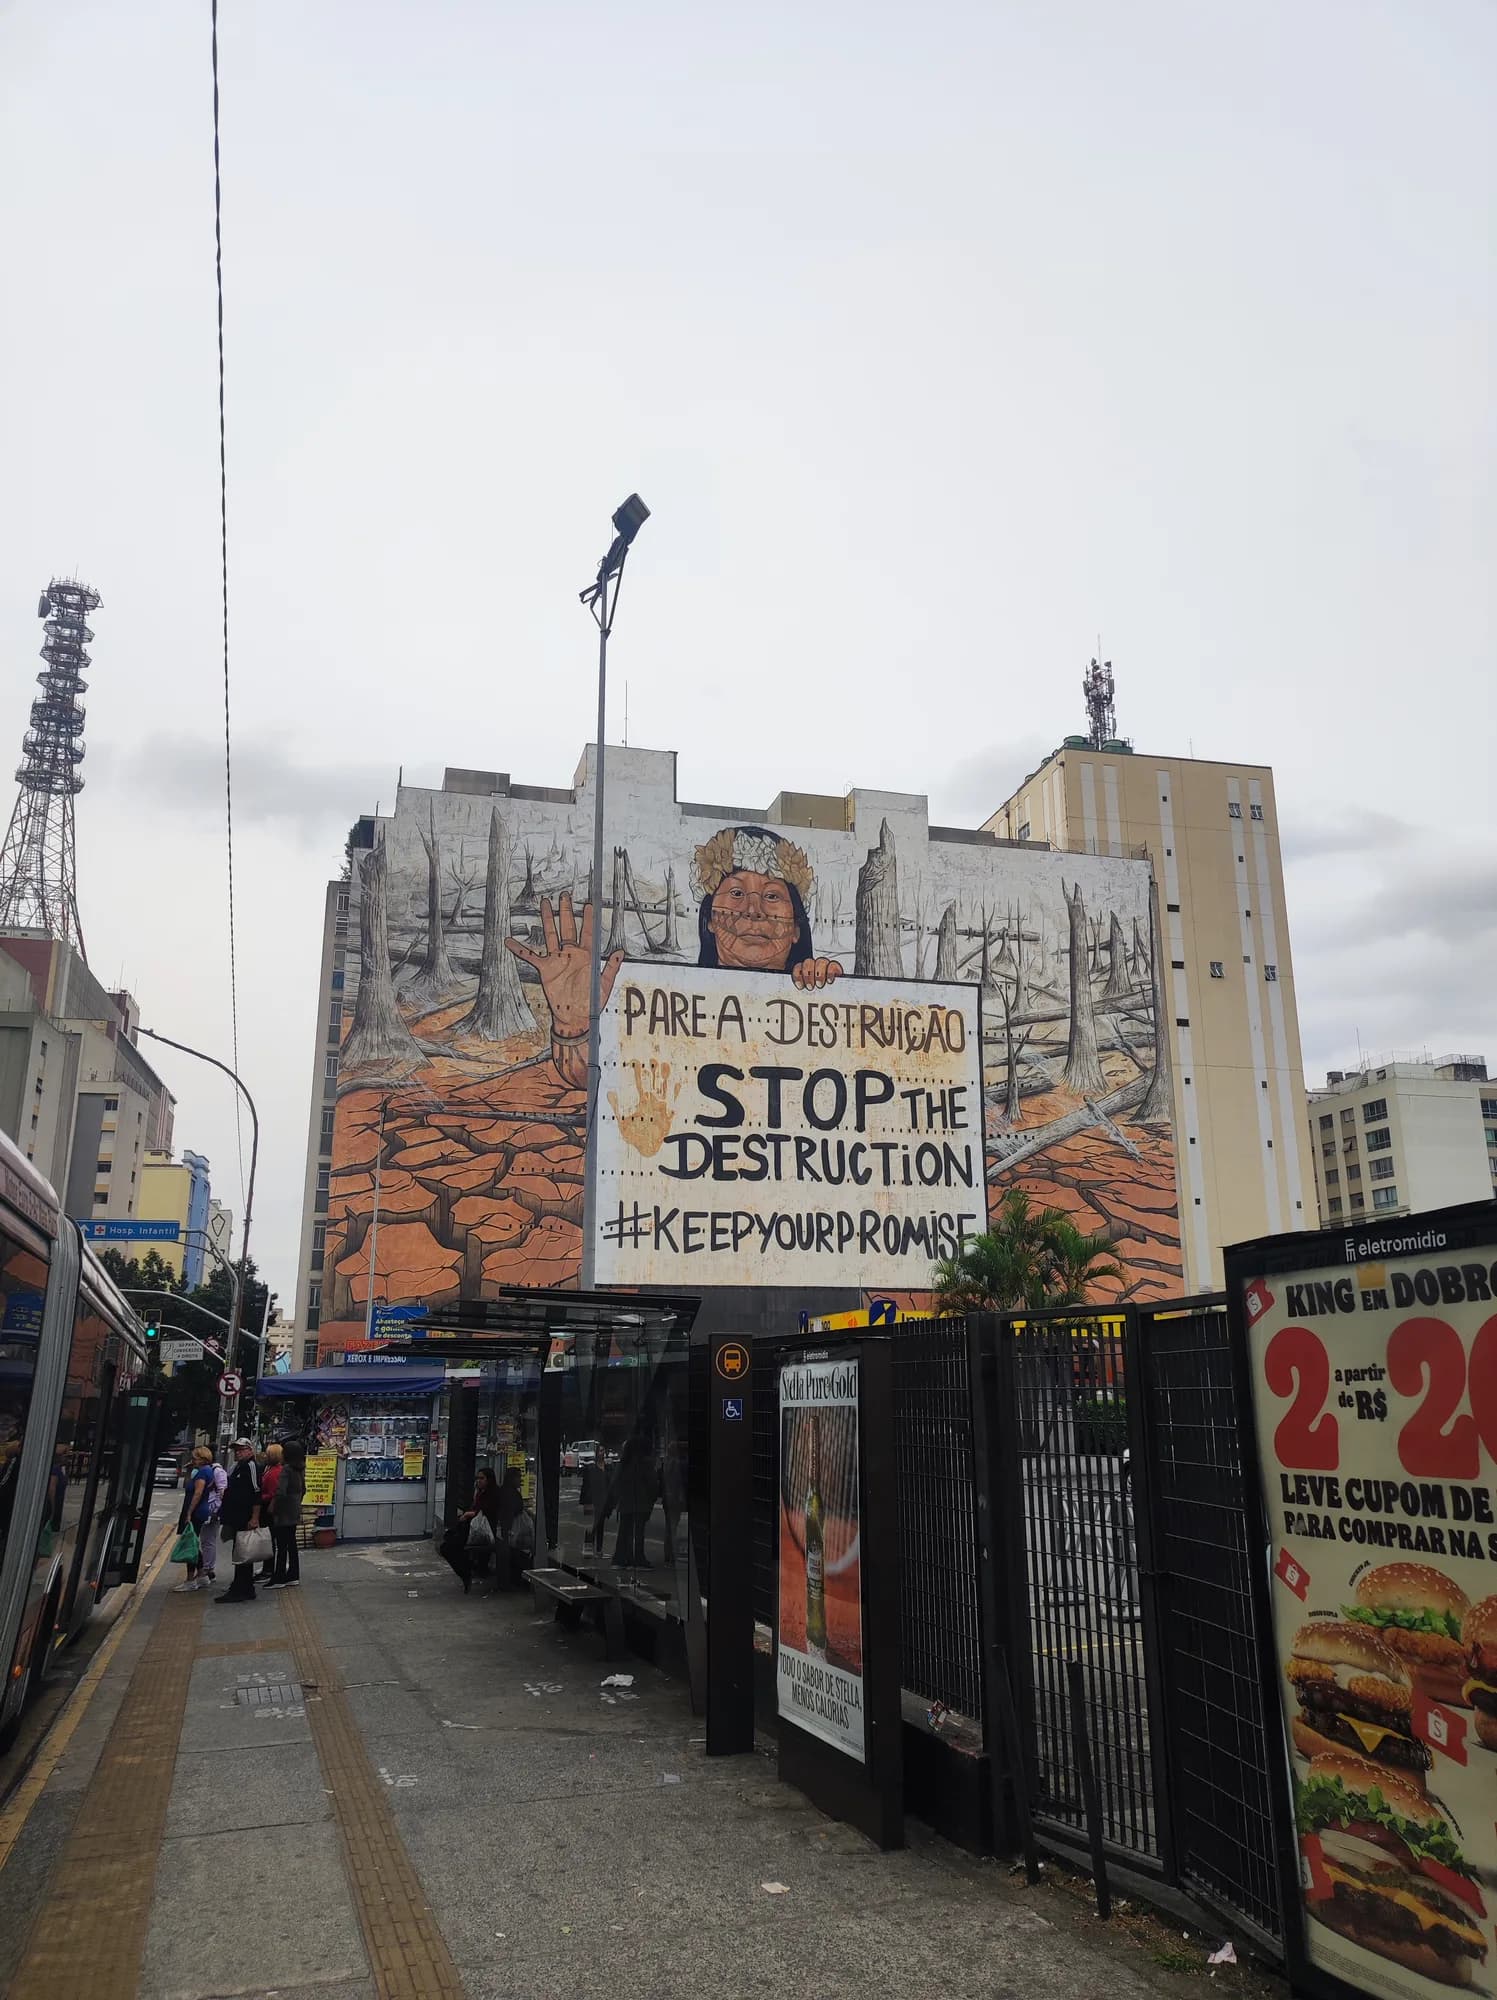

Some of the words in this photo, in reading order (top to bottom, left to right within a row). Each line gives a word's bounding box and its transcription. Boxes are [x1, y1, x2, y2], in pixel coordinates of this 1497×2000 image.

[625, 986, 706, 1038] PARE
[716, 995, 747, 1043] A
[695, 1063, 895, 1133] STOP
[900, 1086, 969, 1130] THE
[110, 1227, 135, 1235] Hosp.
[139, 1227, 176, 1235] Infantil
[1359, 1231, 1447, 1256] eletromidia
[1286, 1278, 1355, 1318] KING
[1360, 1289, 1389, 1312] EM
[1391, 1261, 1497, 1309] DOBR
[347, 1355, 367, 1363] XEROX
[806, 1368, 829, 1400] Pure
[831, 1366, 857, 1400] Gold
[1335, 1368, 1343, 1382] a
[1344, 1363, 1386, 1386] partir
[1265, 1327, 1340, 1471] 2
[1338, 1391, 1355, 1408] de
[1356, 1388, 1388, 1422] R$
[1280, 1473, 1342, 1509] LEVE
[1345, 1478, 1447, 1520] CUPOM
[1450, 1485, 1494, 1524] DE
[1284, 1511, 1336, 1540] PARA
[1338, 1516, 1447, 1555] COMPRAR
[1448, 1528, 1485, 1560] NA
[780, 1652, 796, 1679] TODO
[796, 1660, 802, 1681] O
[803, 1662, 824, 1692] SABOR
[825, 1672, 834, 1698] DE
[836, 1676, 862, 1713] STELLA,
[792, 1681, 815, 1713] MENOS
[815, 1693, 849, 1730] CALORIAS
